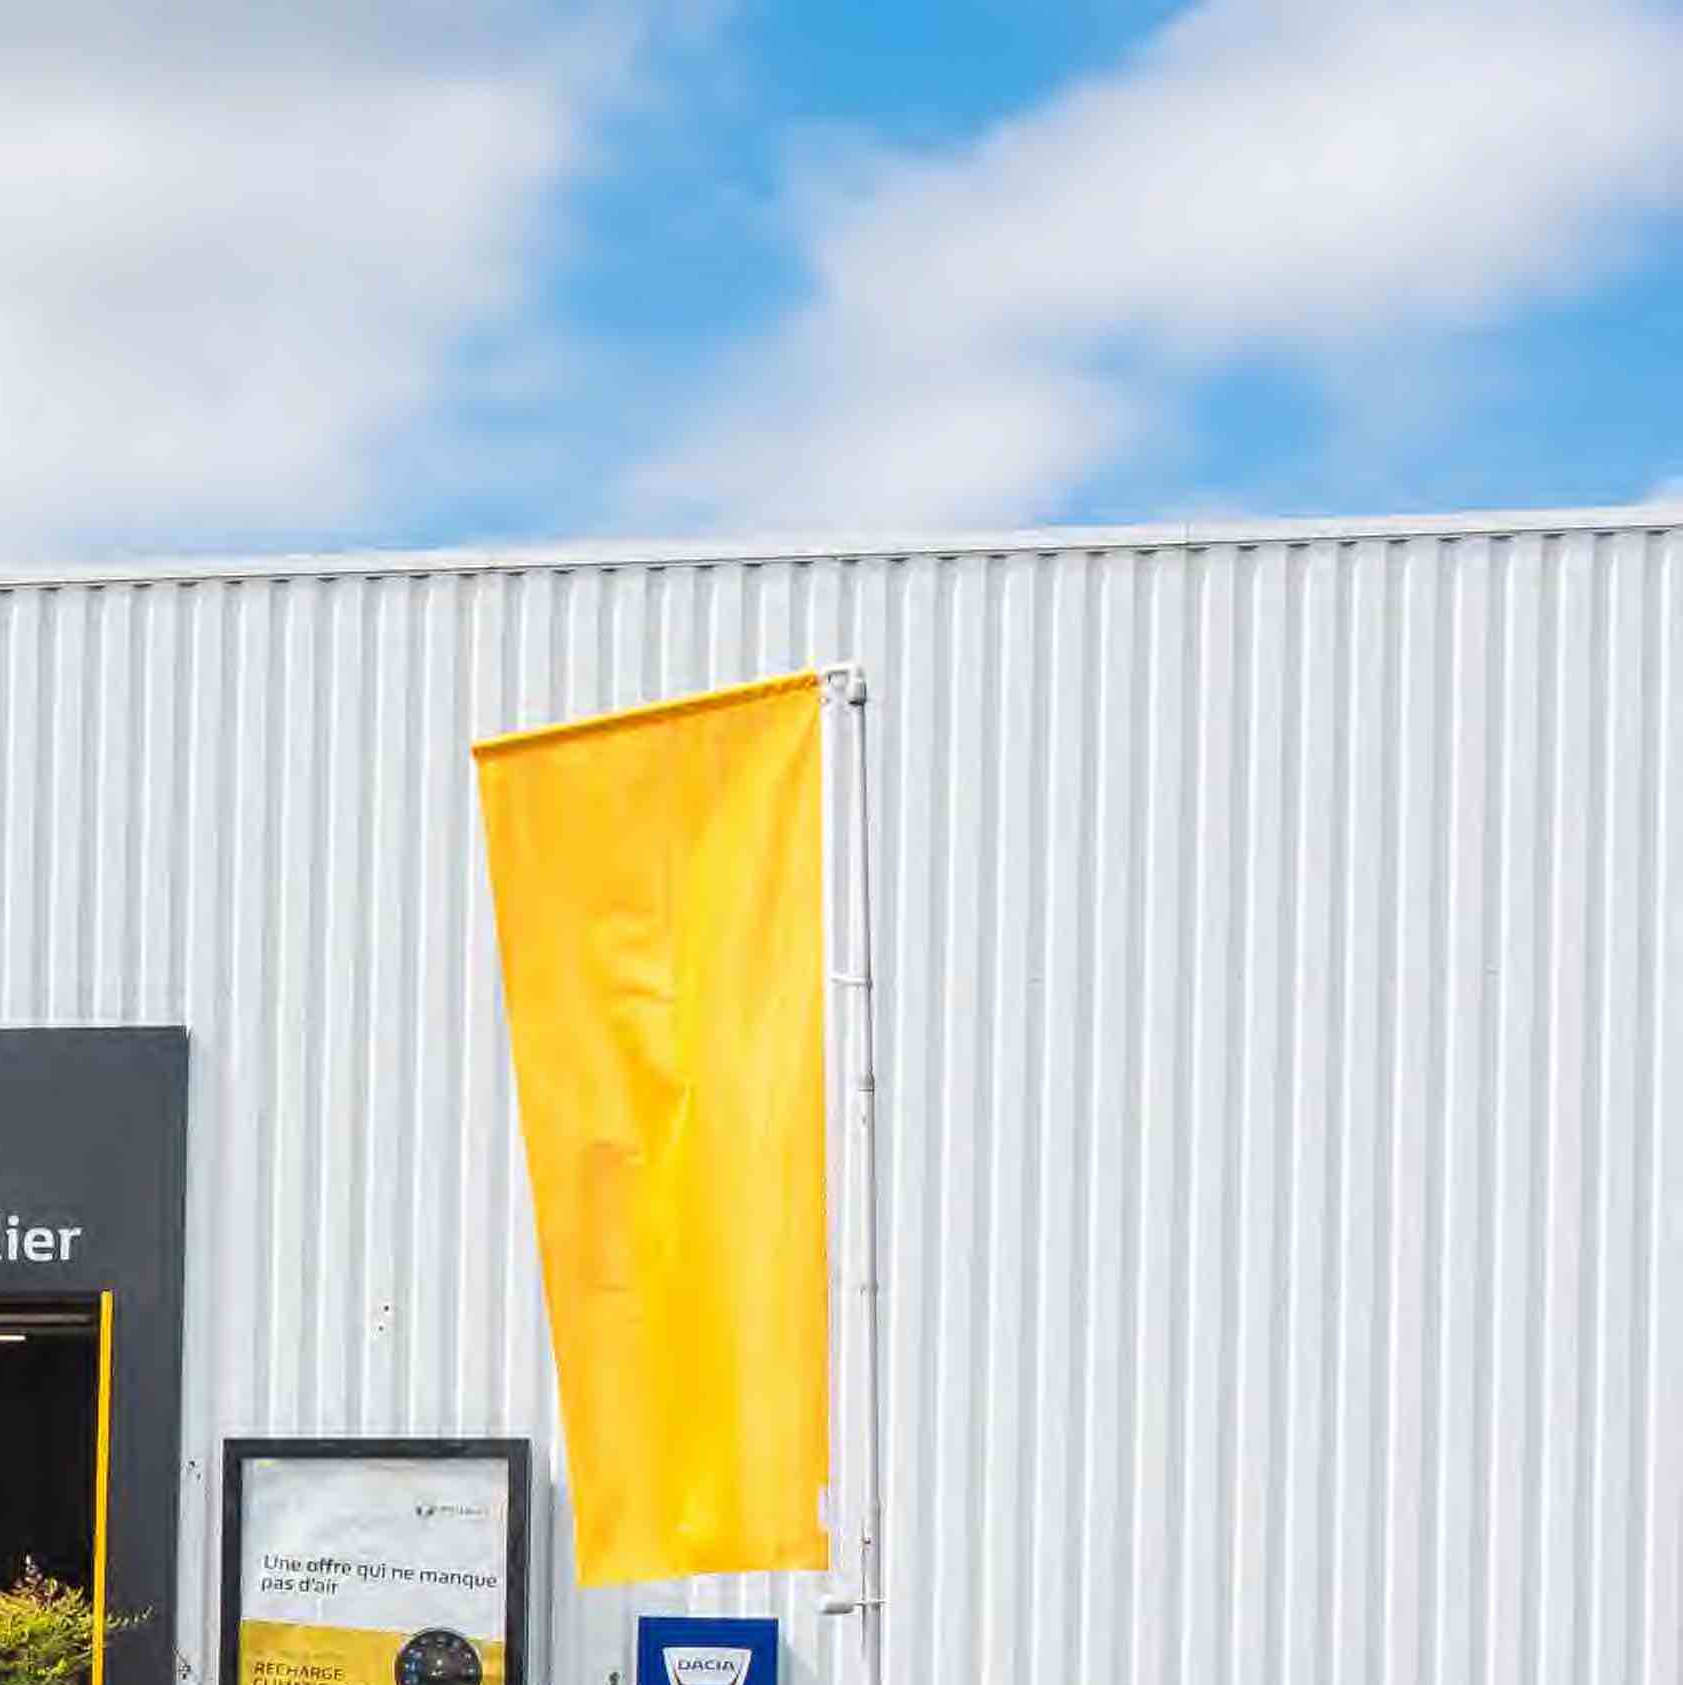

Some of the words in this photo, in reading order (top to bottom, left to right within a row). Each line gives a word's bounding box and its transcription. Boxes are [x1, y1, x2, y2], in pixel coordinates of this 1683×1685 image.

[263, 1554, 302, 1572] Une
[306, 1557, 352, 1576] offre
[357, 1562, 386, 1580] qui
[391, 1567, 414, 1581] ne
[419, 1569, 498, 1590] manque
[260, 1576, 293, 1592] pas
[298, 1576, 339, 1595] d'air
[253, 1661, 345, 1681] RECHARGE
[677, 1659, 735, 1672] DACIA
